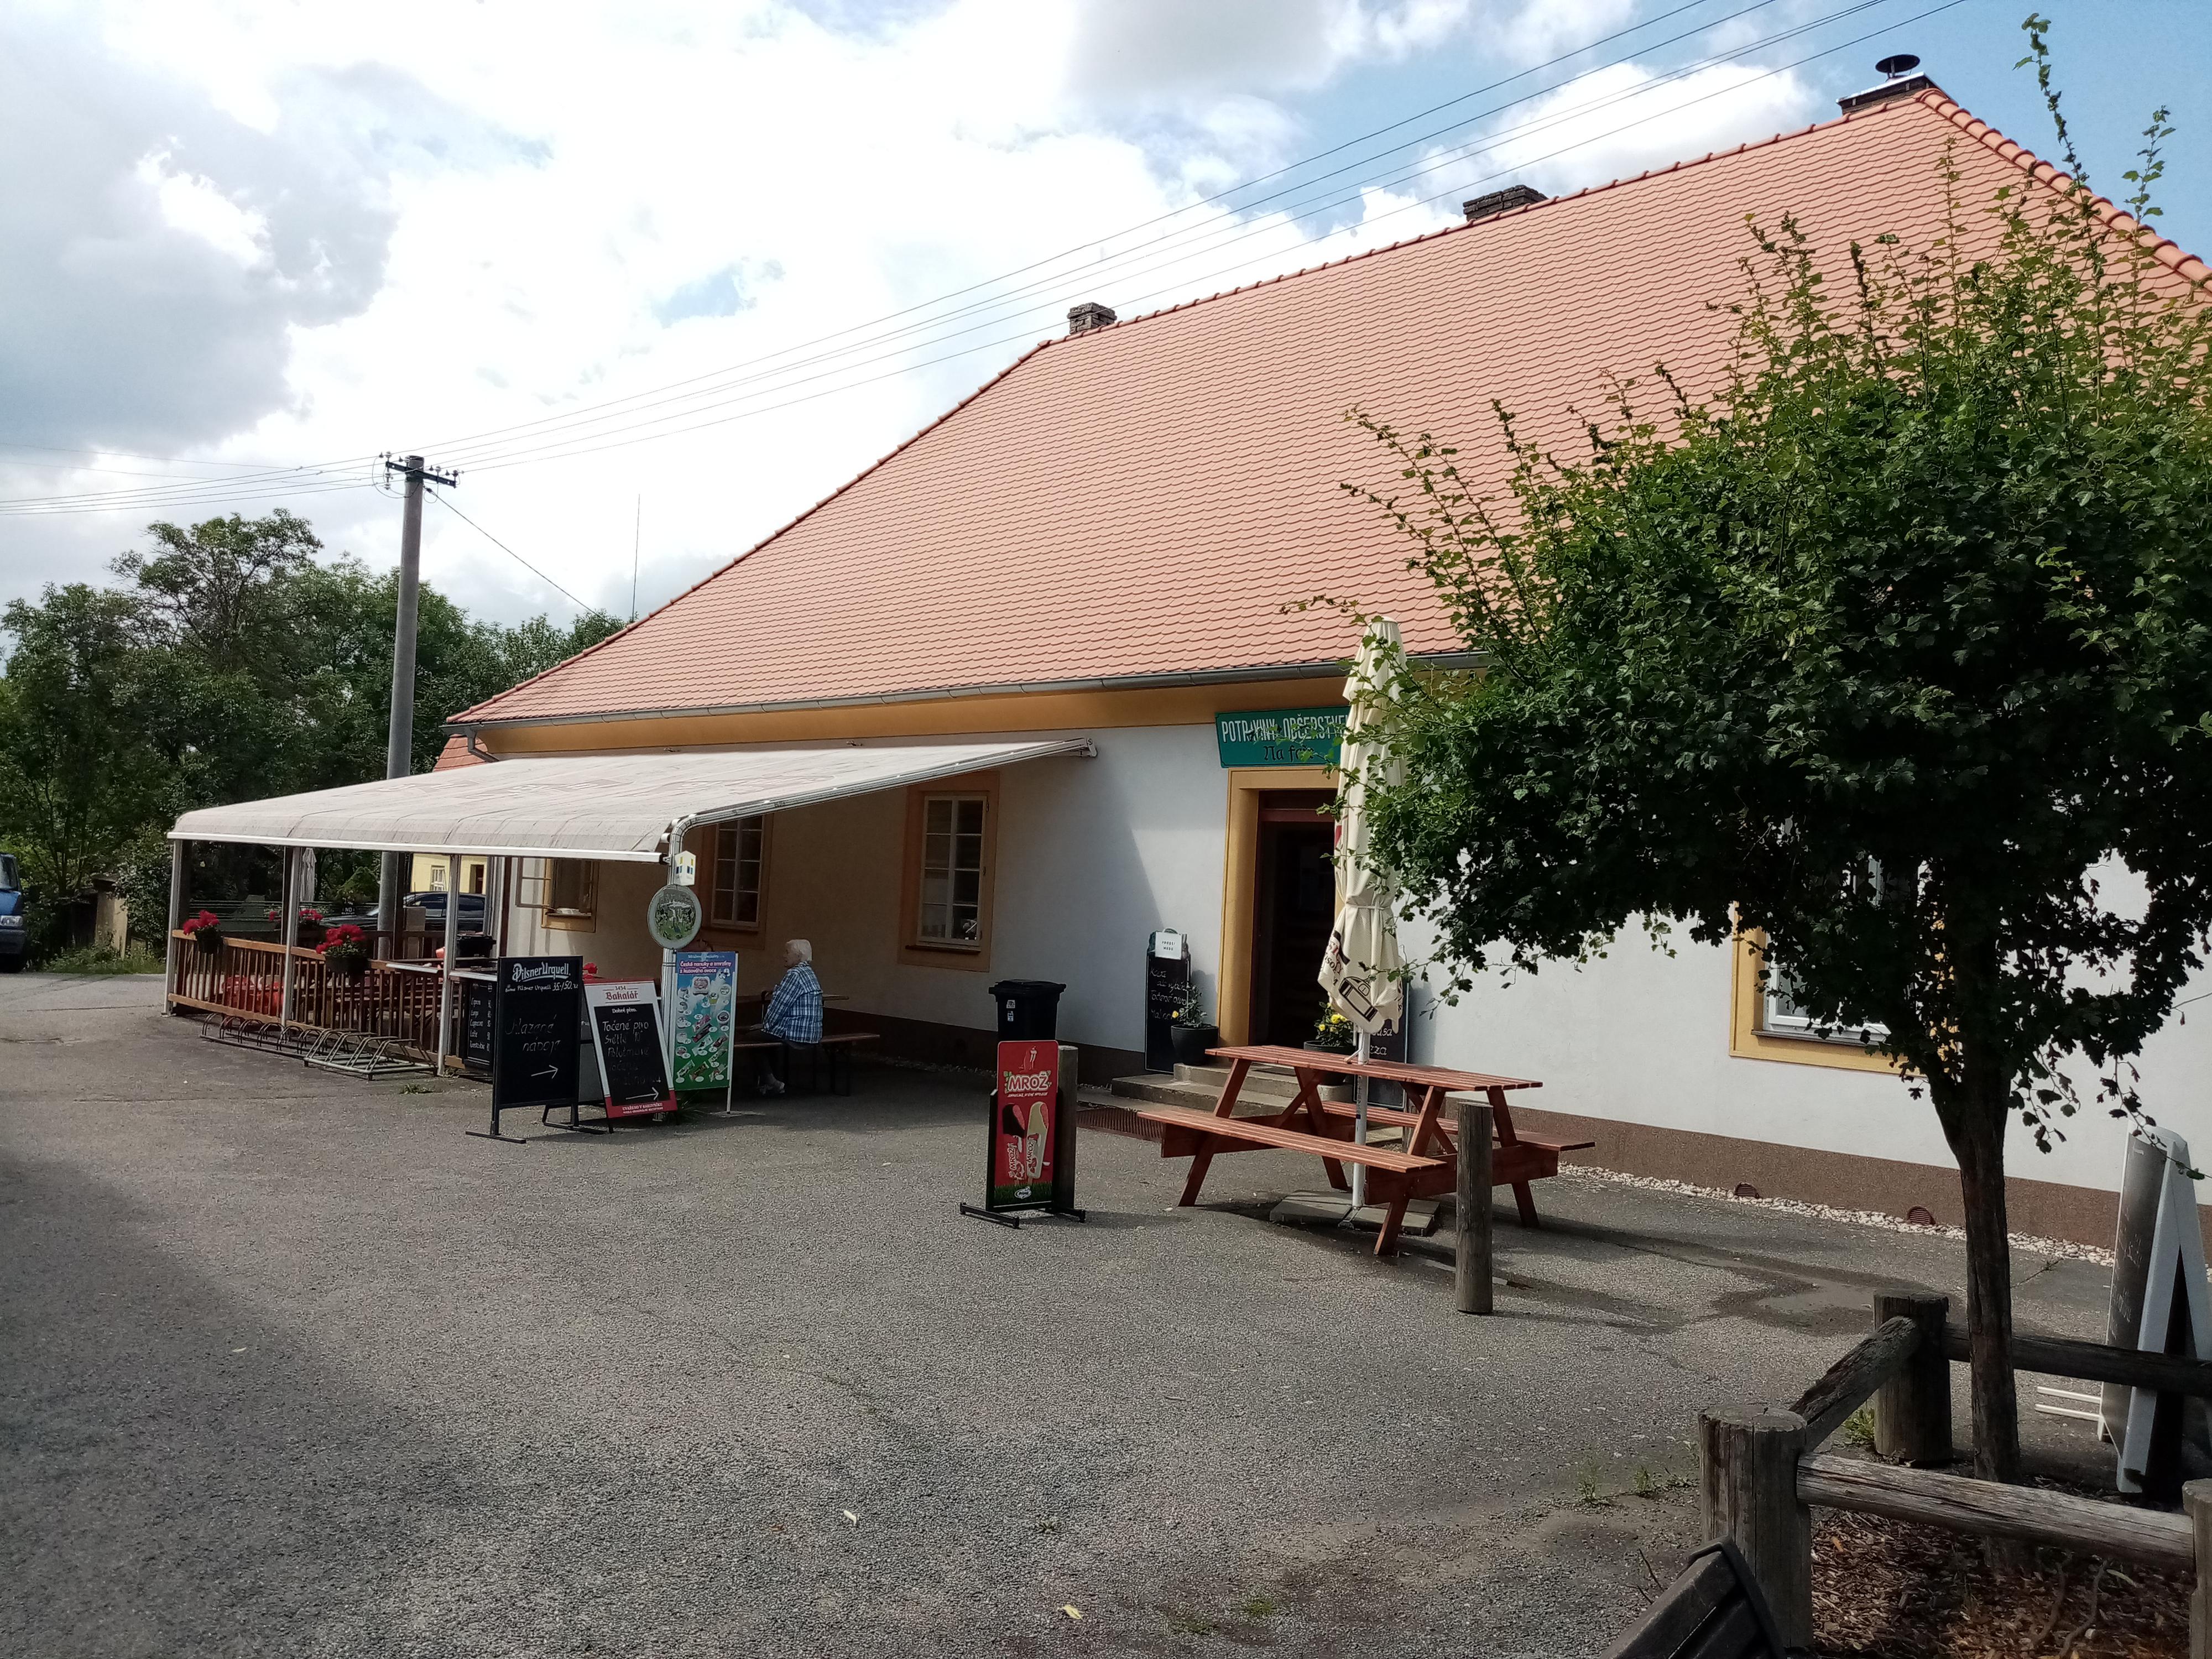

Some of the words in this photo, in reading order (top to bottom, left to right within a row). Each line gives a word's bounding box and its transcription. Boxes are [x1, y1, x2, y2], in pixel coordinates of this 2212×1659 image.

[1222, 718, 1276, 743] POTRAVINY
[1264, 745, 1284, 760] Na
[512, 963, 542, 982] Pilsner
[606, 990, 638, 1000] Bakalář
[1008, 1071, 1048, 1091] MROŽ
